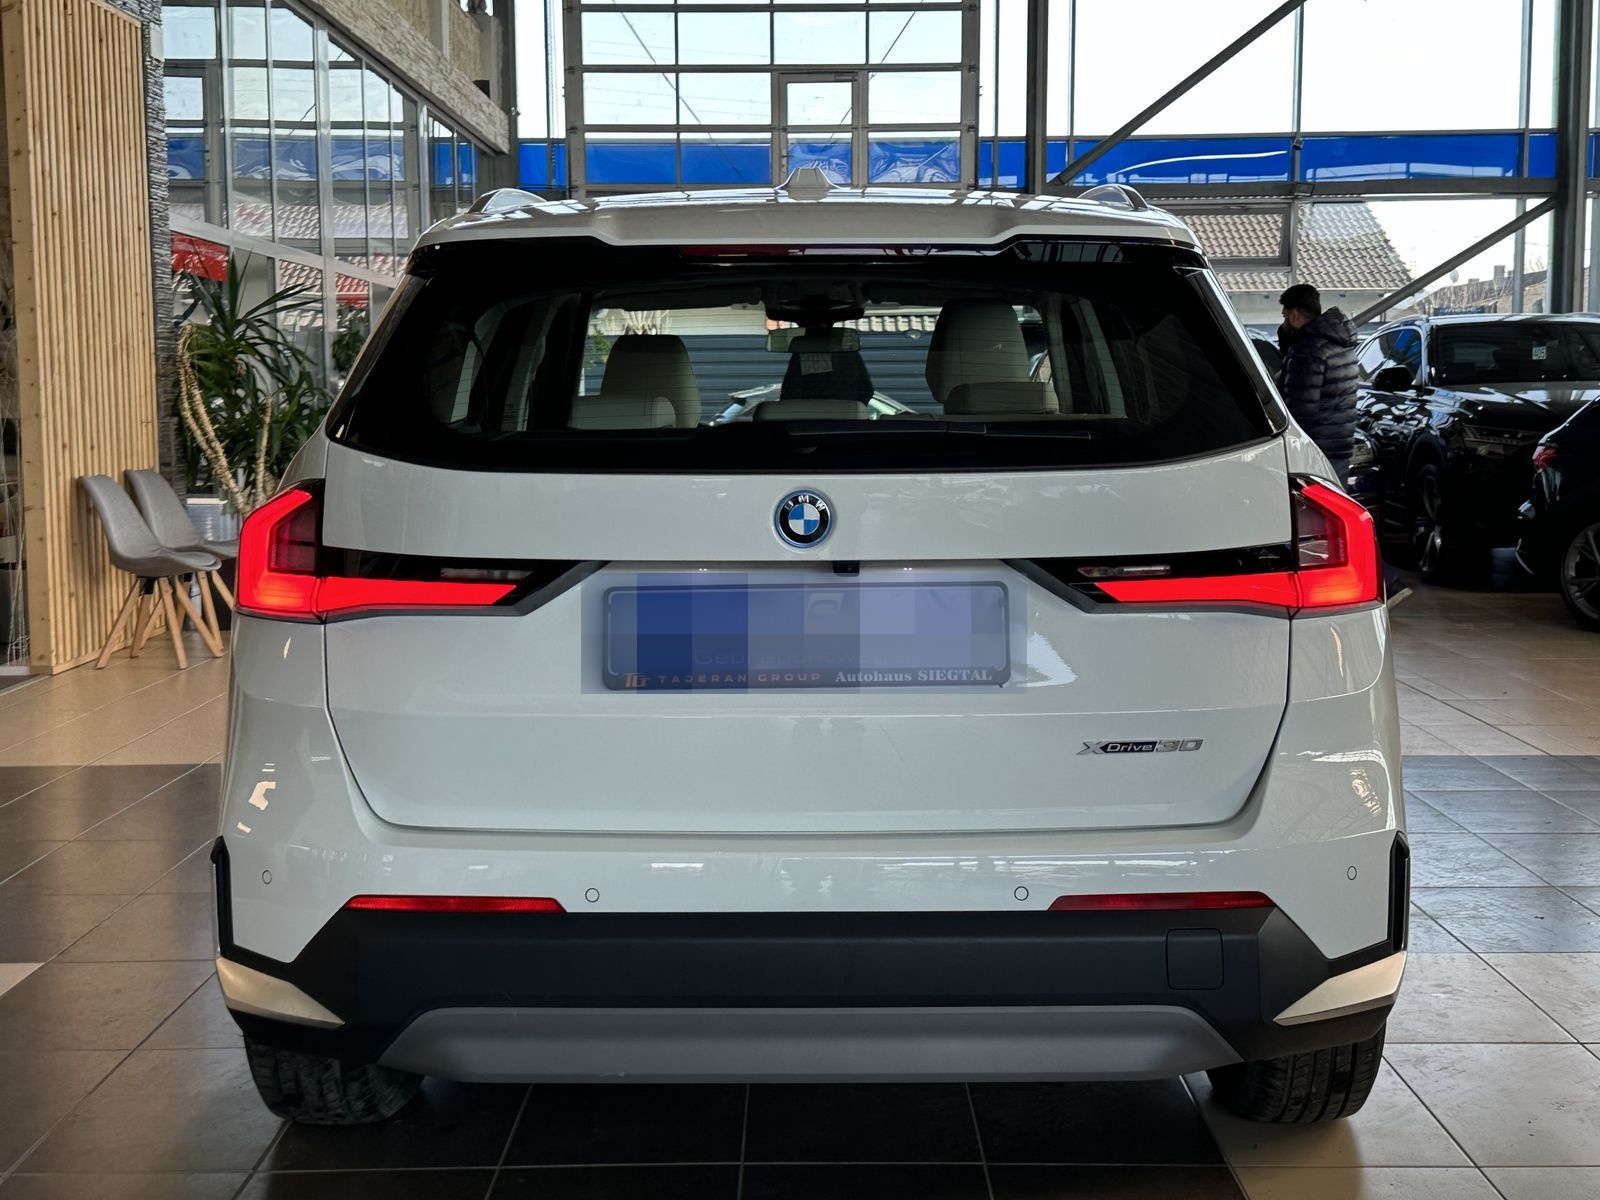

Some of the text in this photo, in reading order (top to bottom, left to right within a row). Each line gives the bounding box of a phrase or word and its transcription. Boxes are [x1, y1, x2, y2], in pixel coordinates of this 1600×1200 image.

[784, 494, 826, 511] BMW
[658, 675, 747, 684] TAJERAN
[757, 673, 820, 682] GROUP
[835, 671, 912, 682] Autohaus
[917, 669, 992, 681] SIEGTAL
